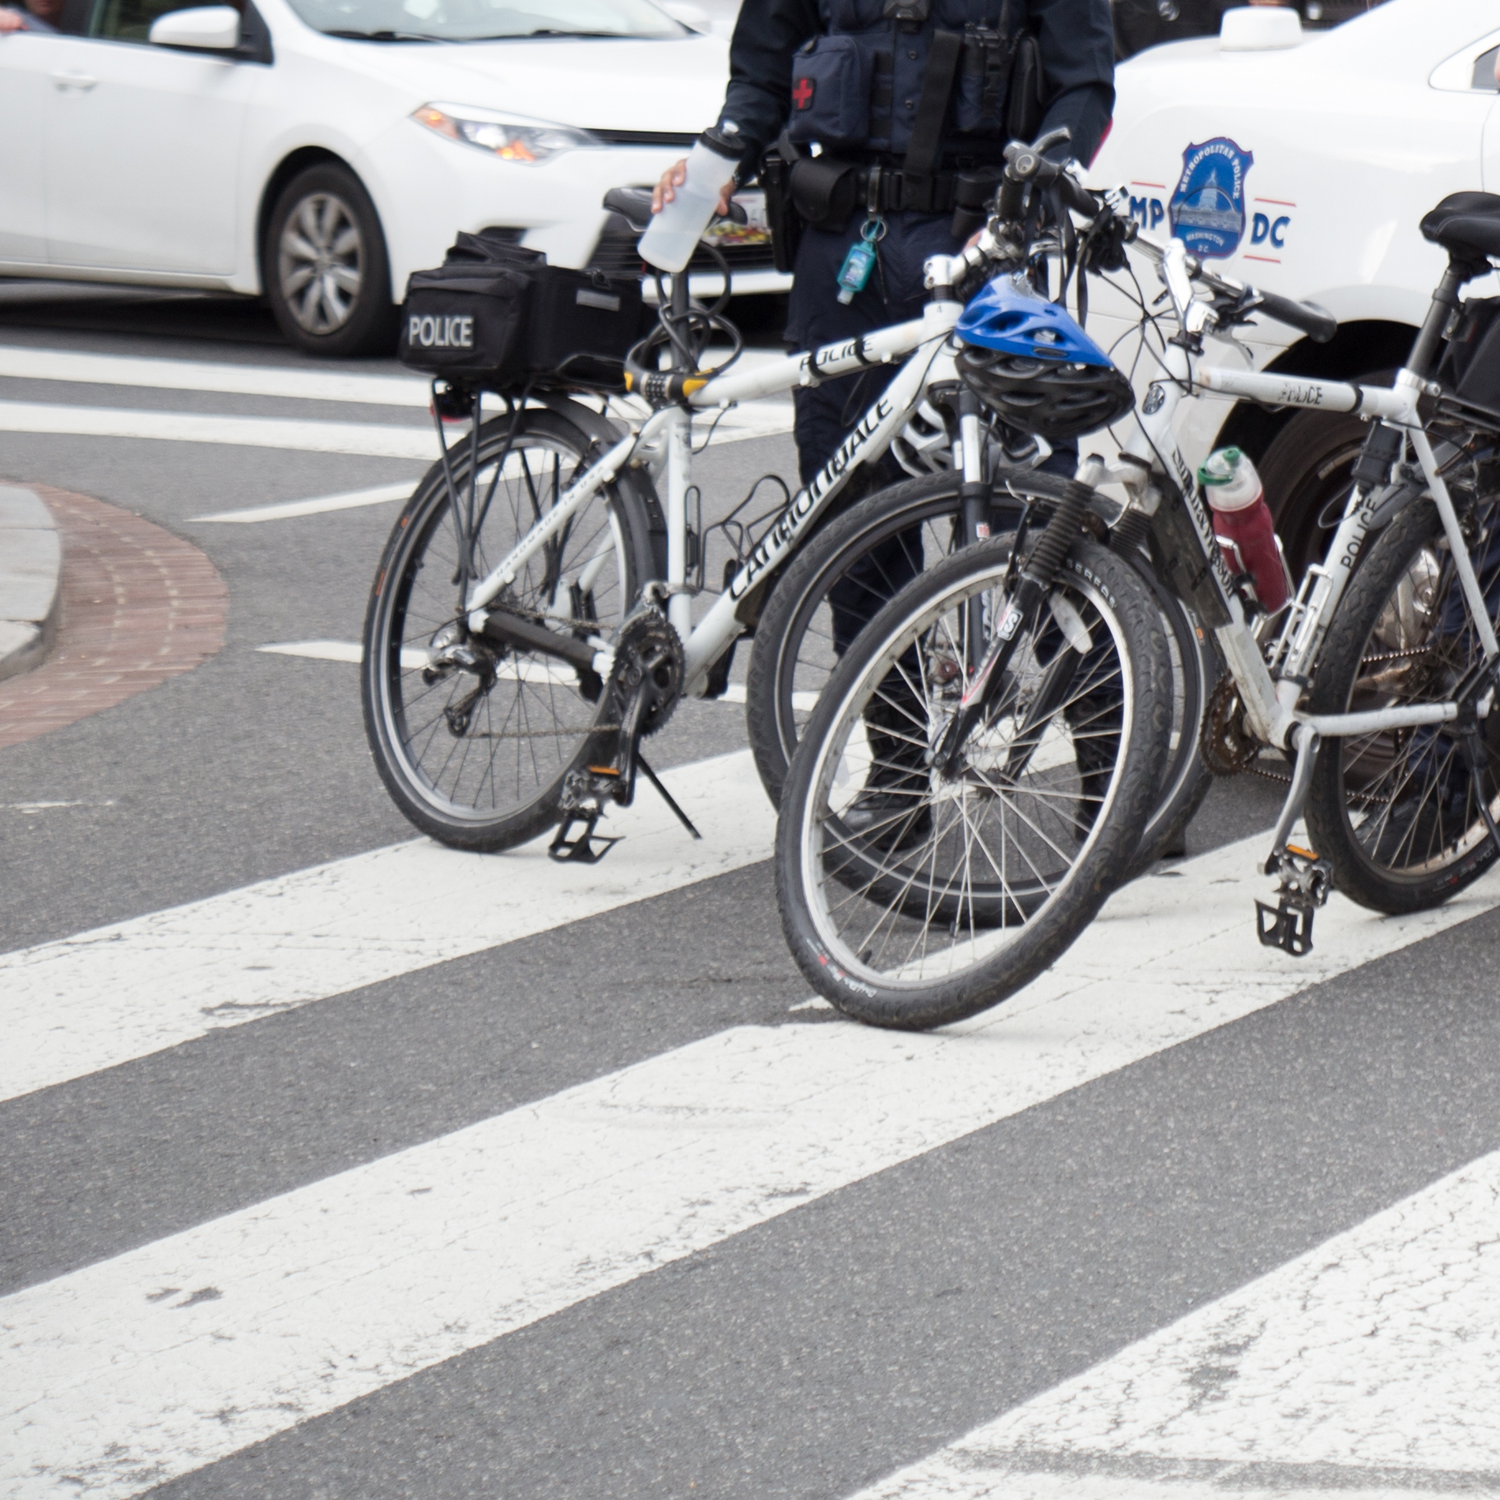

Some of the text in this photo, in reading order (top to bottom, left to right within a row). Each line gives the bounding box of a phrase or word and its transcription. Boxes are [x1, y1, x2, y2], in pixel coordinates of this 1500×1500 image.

[1180, 143, 1244, 200] METROPOLITAN POLICE
[1129, 195, 1291, 250] MP DC
[1185, 233, 1225, 248] WASHINGTON
[408, 314, 474, 347] POLICE
[496, 509, 560, 578] HANDMADE
[1341, 497, 1378, 570] POLICE
